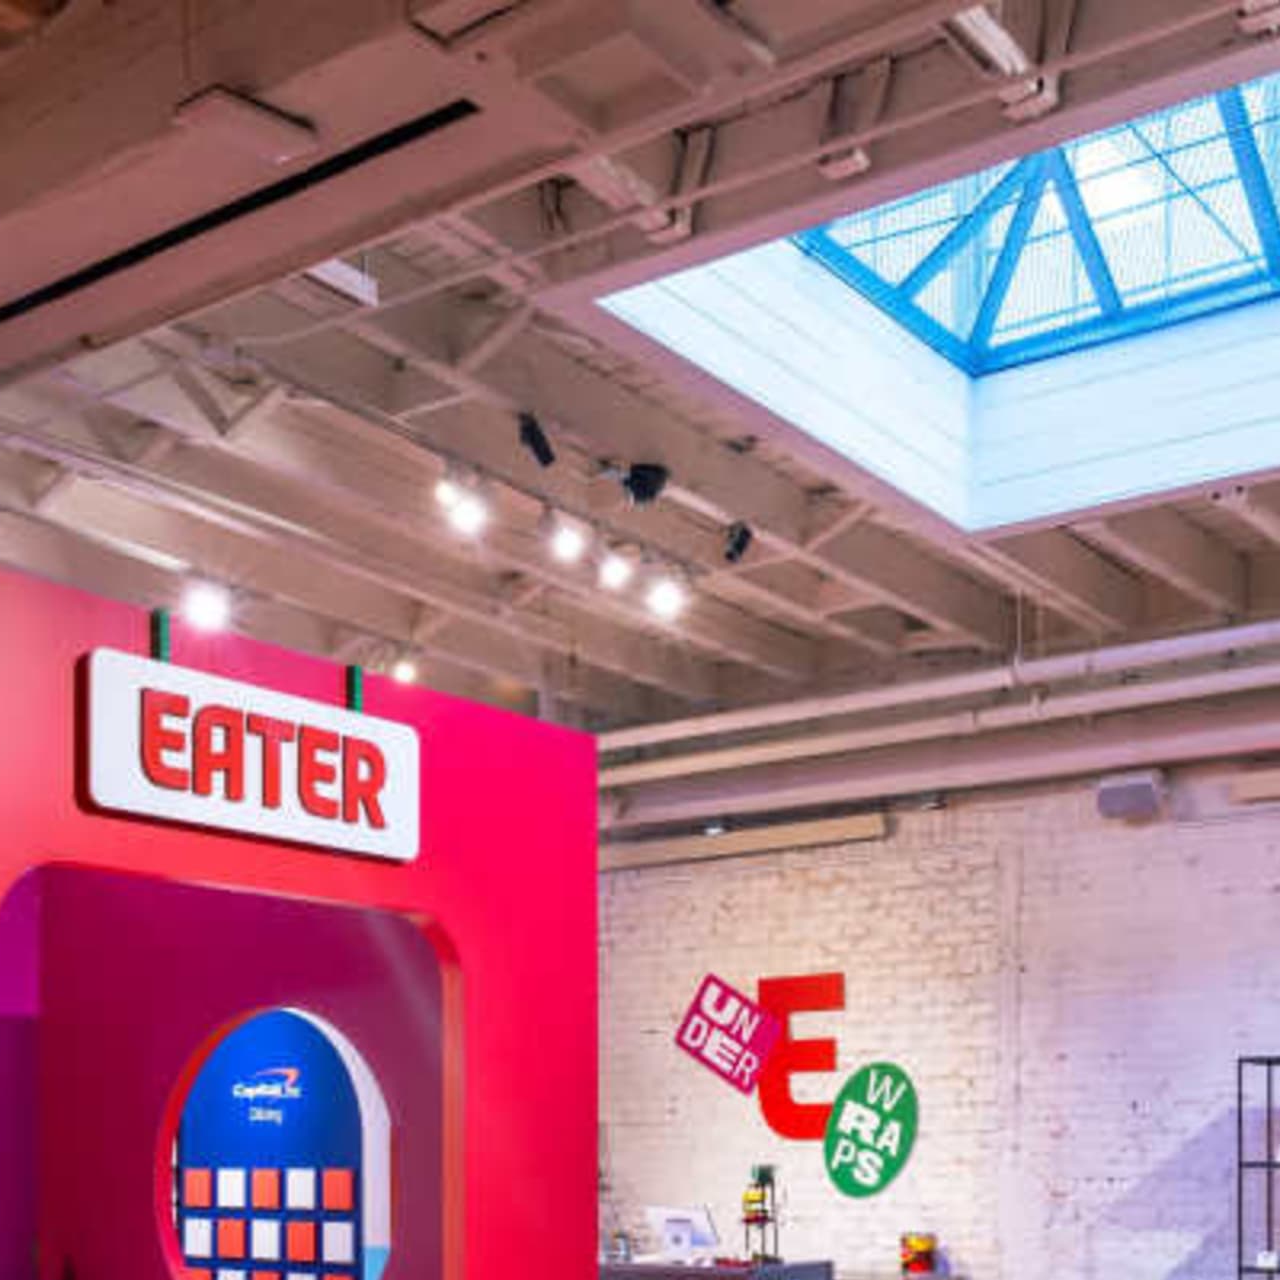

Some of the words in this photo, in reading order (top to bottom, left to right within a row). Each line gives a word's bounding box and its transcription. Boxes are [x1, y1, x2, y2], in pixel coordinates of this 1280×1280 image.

[138, 686, 387, 829] EATER
[699, 982, 761, 1045] UN
[681, 1015, 760, 1087] DER
[757, 971, 845, 1141] E
[867, 1069, 907, 1113] W
[836, 1100, 902, 1157] RA
[831, 1138, 883, 1188] PS
